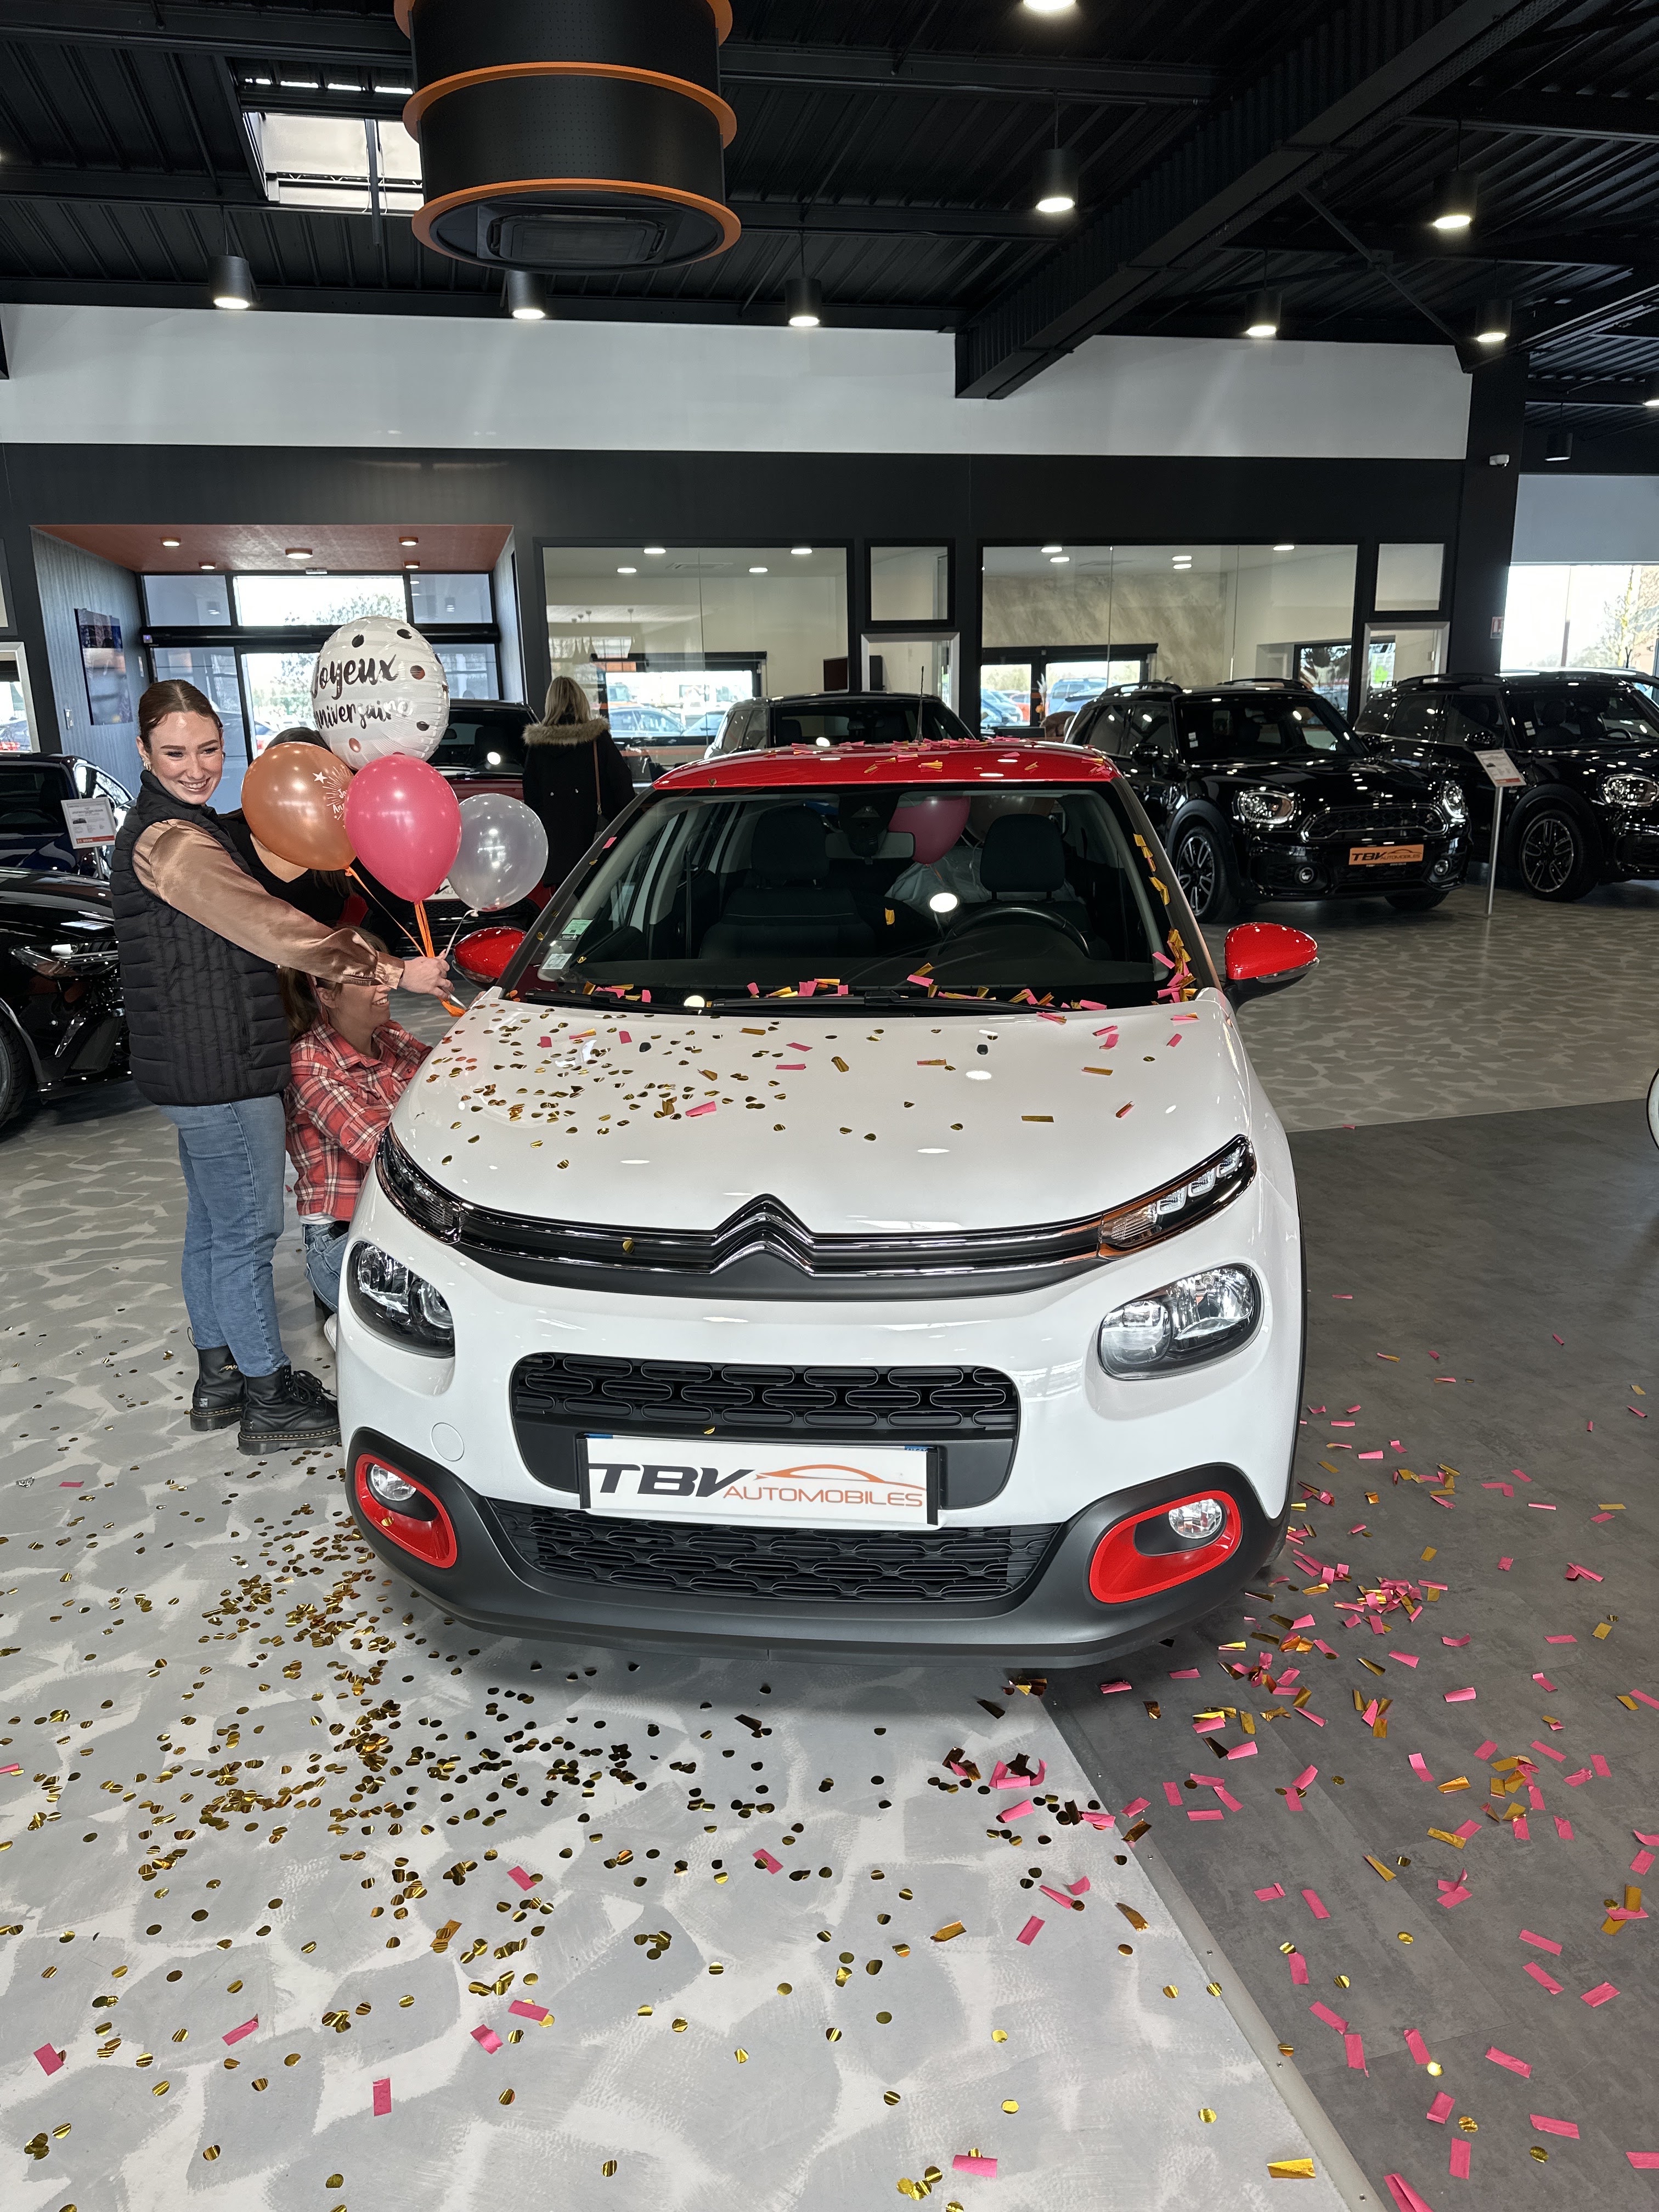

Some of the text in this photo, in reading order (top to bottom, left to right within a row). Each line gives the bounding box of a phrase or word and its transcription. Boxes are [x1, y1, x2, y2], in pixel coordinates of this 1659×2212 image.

[311, 654, 399, 700] Joyeux
[1352, 851, 1387, 861] TBV
[588, 1463, 923, 1507] TBV AUTOMOBILES
